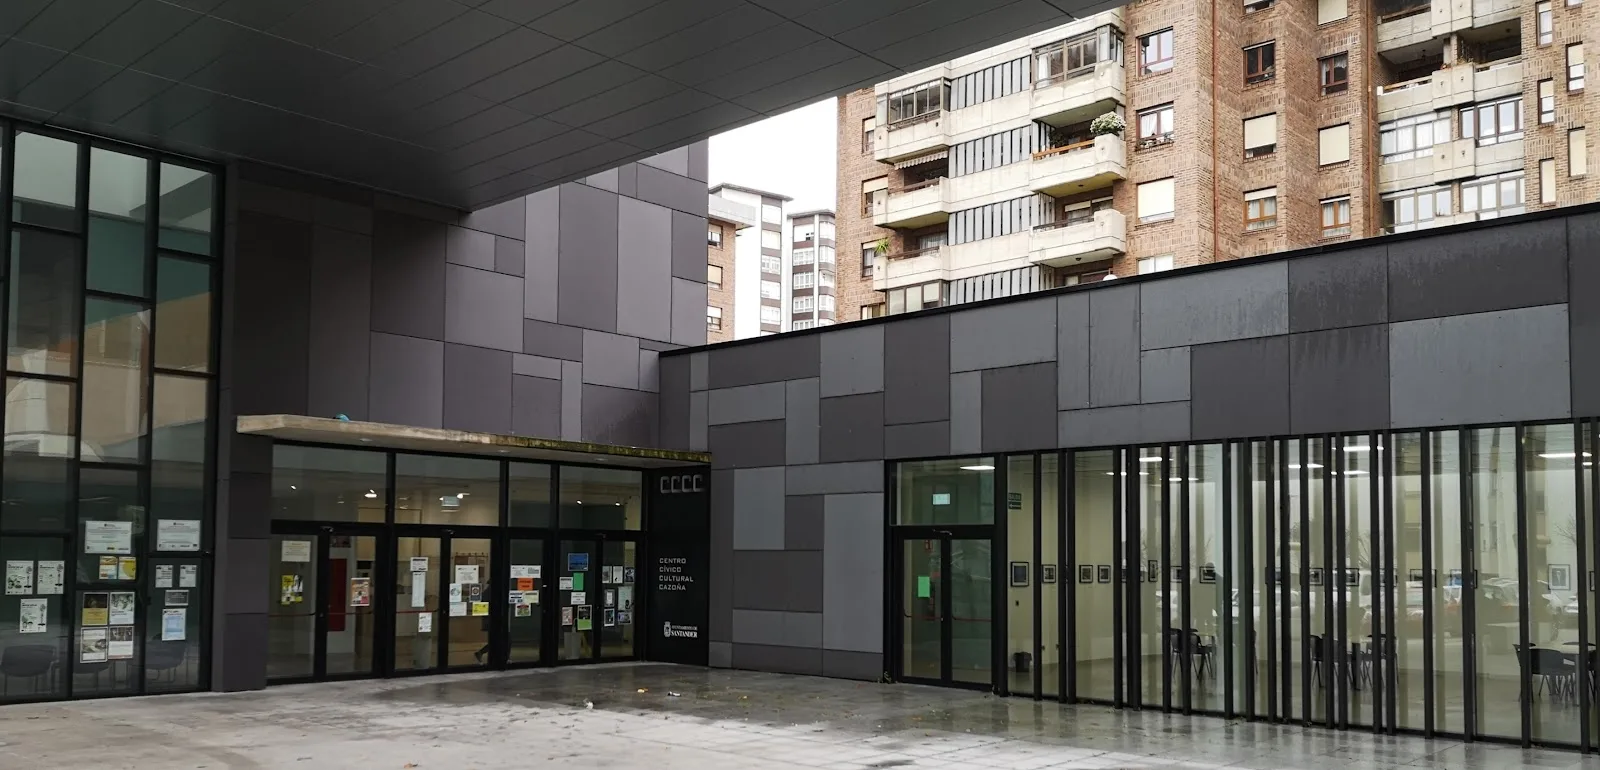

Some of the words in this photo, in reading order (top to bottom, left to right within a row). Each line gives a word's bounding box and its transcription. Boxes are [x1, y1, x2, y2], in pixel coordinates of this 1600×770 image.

[659, 565, 682, 573] CÍVICO
[659, 583, 687, 591] CAZOÑA
[671, 630, 698, 638] SANTANDER
